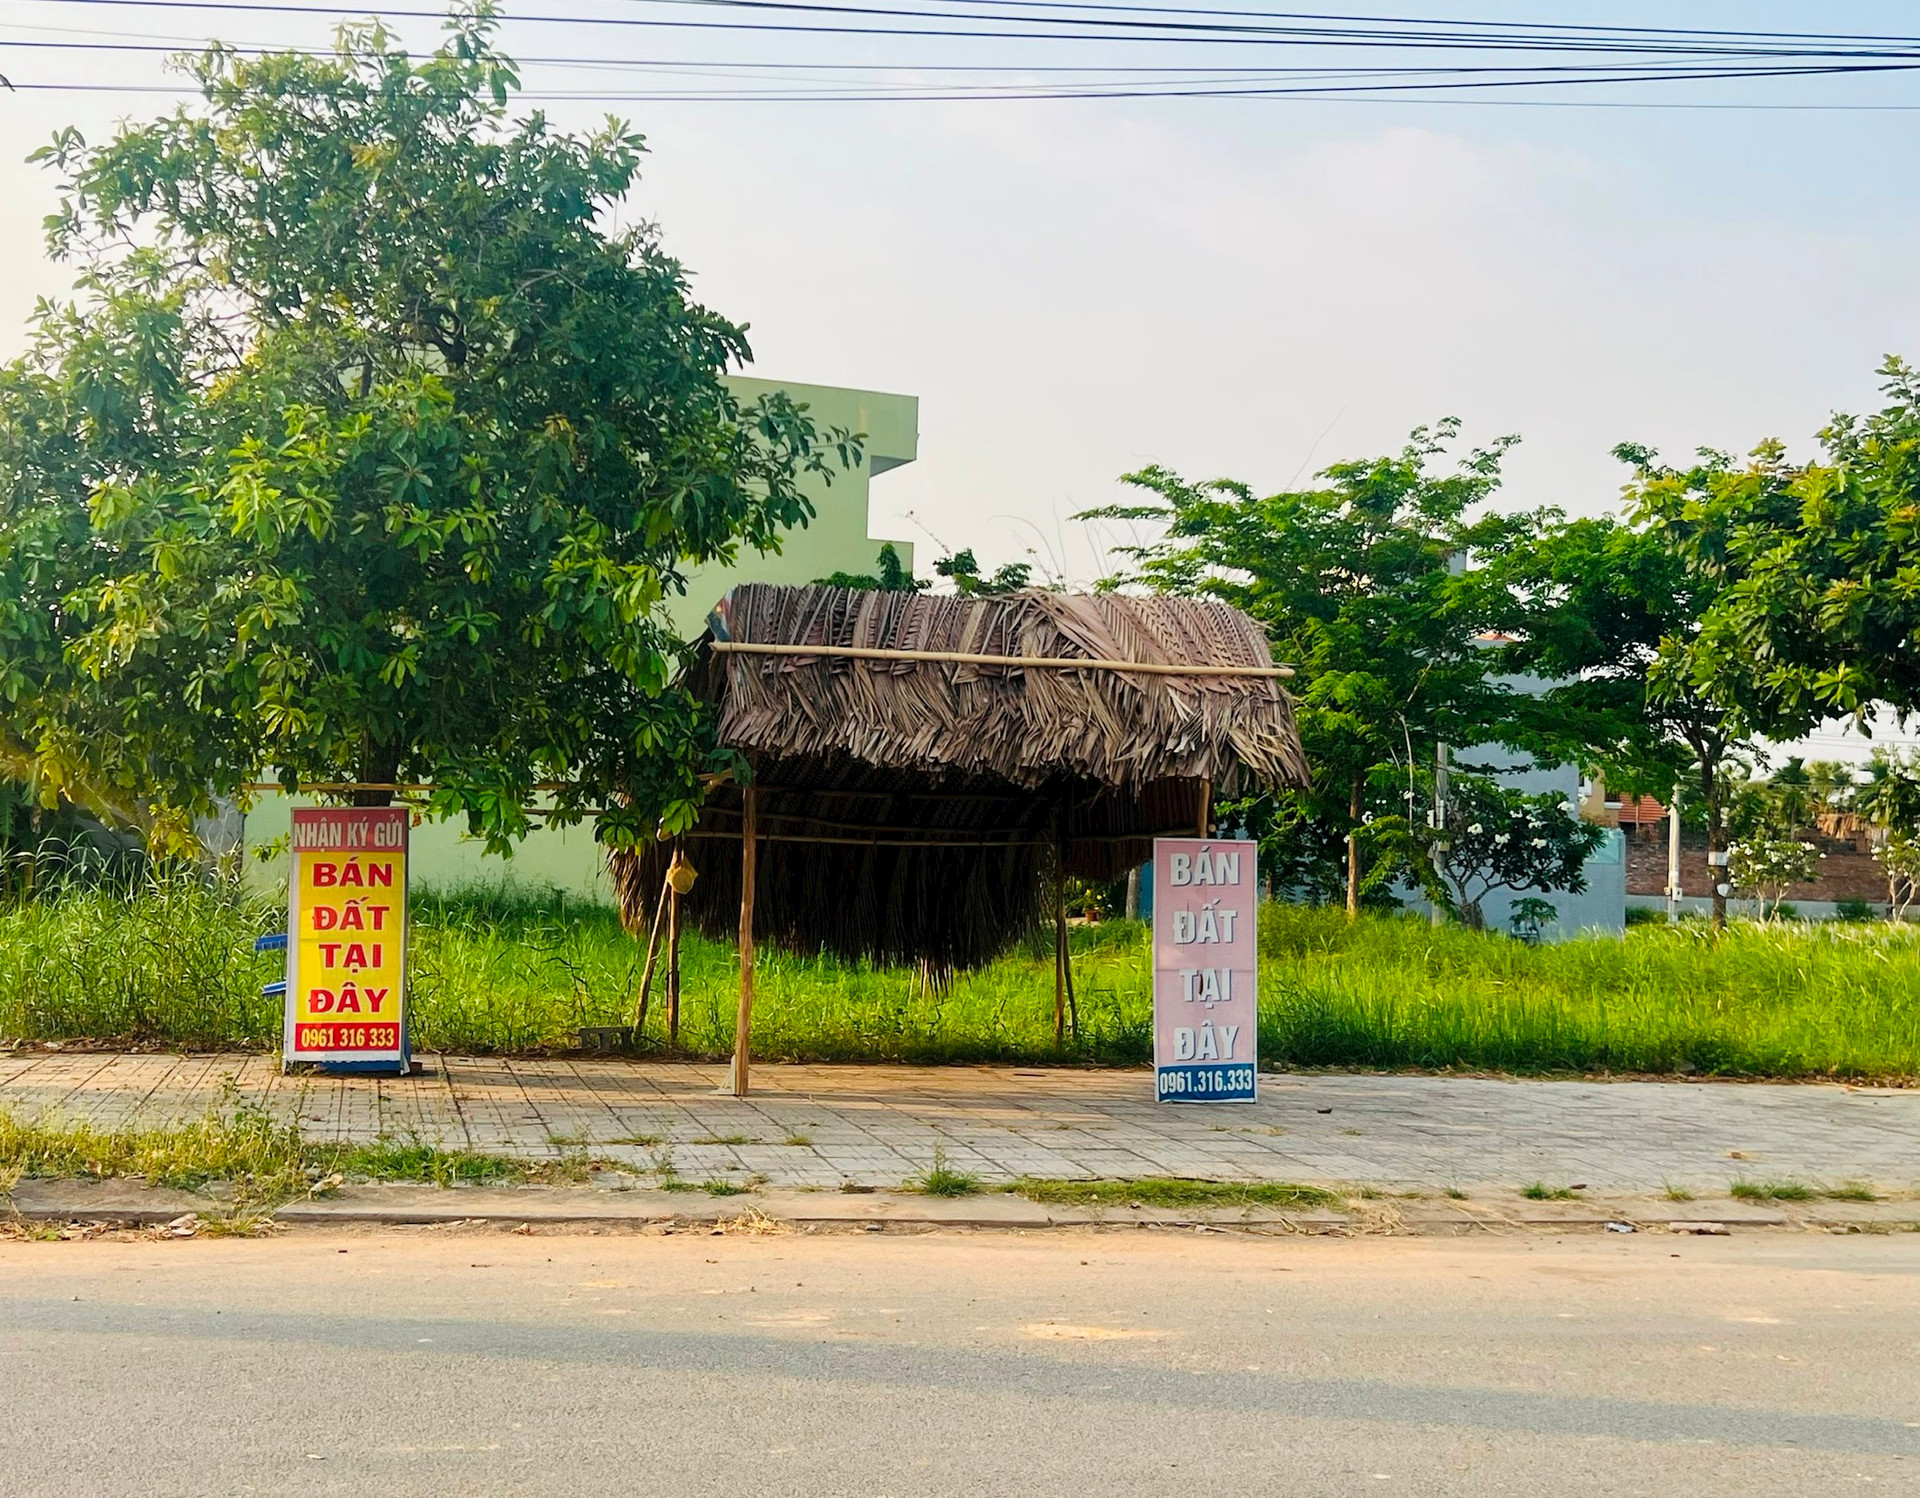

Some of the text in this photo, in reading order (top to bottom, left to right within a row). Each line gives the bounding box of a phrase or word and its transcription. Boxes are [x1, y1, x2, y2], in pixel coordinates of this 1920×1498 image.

[294, 813, 403, 853] NHẬN KÝ GỬI
[312, 856, 393, 888] BÁN
[1169, 845, 1240, 887] BÁN
[311, 895, 391, 931] ĐẤT
[1172, 899, 1238, 944] ĐẤT
[318, 943, 383, 974] TẠI
[308, 981, 389, 1014] ĐÂY
[1179, 967, 1232, 1010] TẠI
[301, 1027, 395, 1048] 0961 316 333
[1172, 1019, 1240, 1062] ĐÂY
[1159, 1068, 1253, 1095] 0961.316.333
